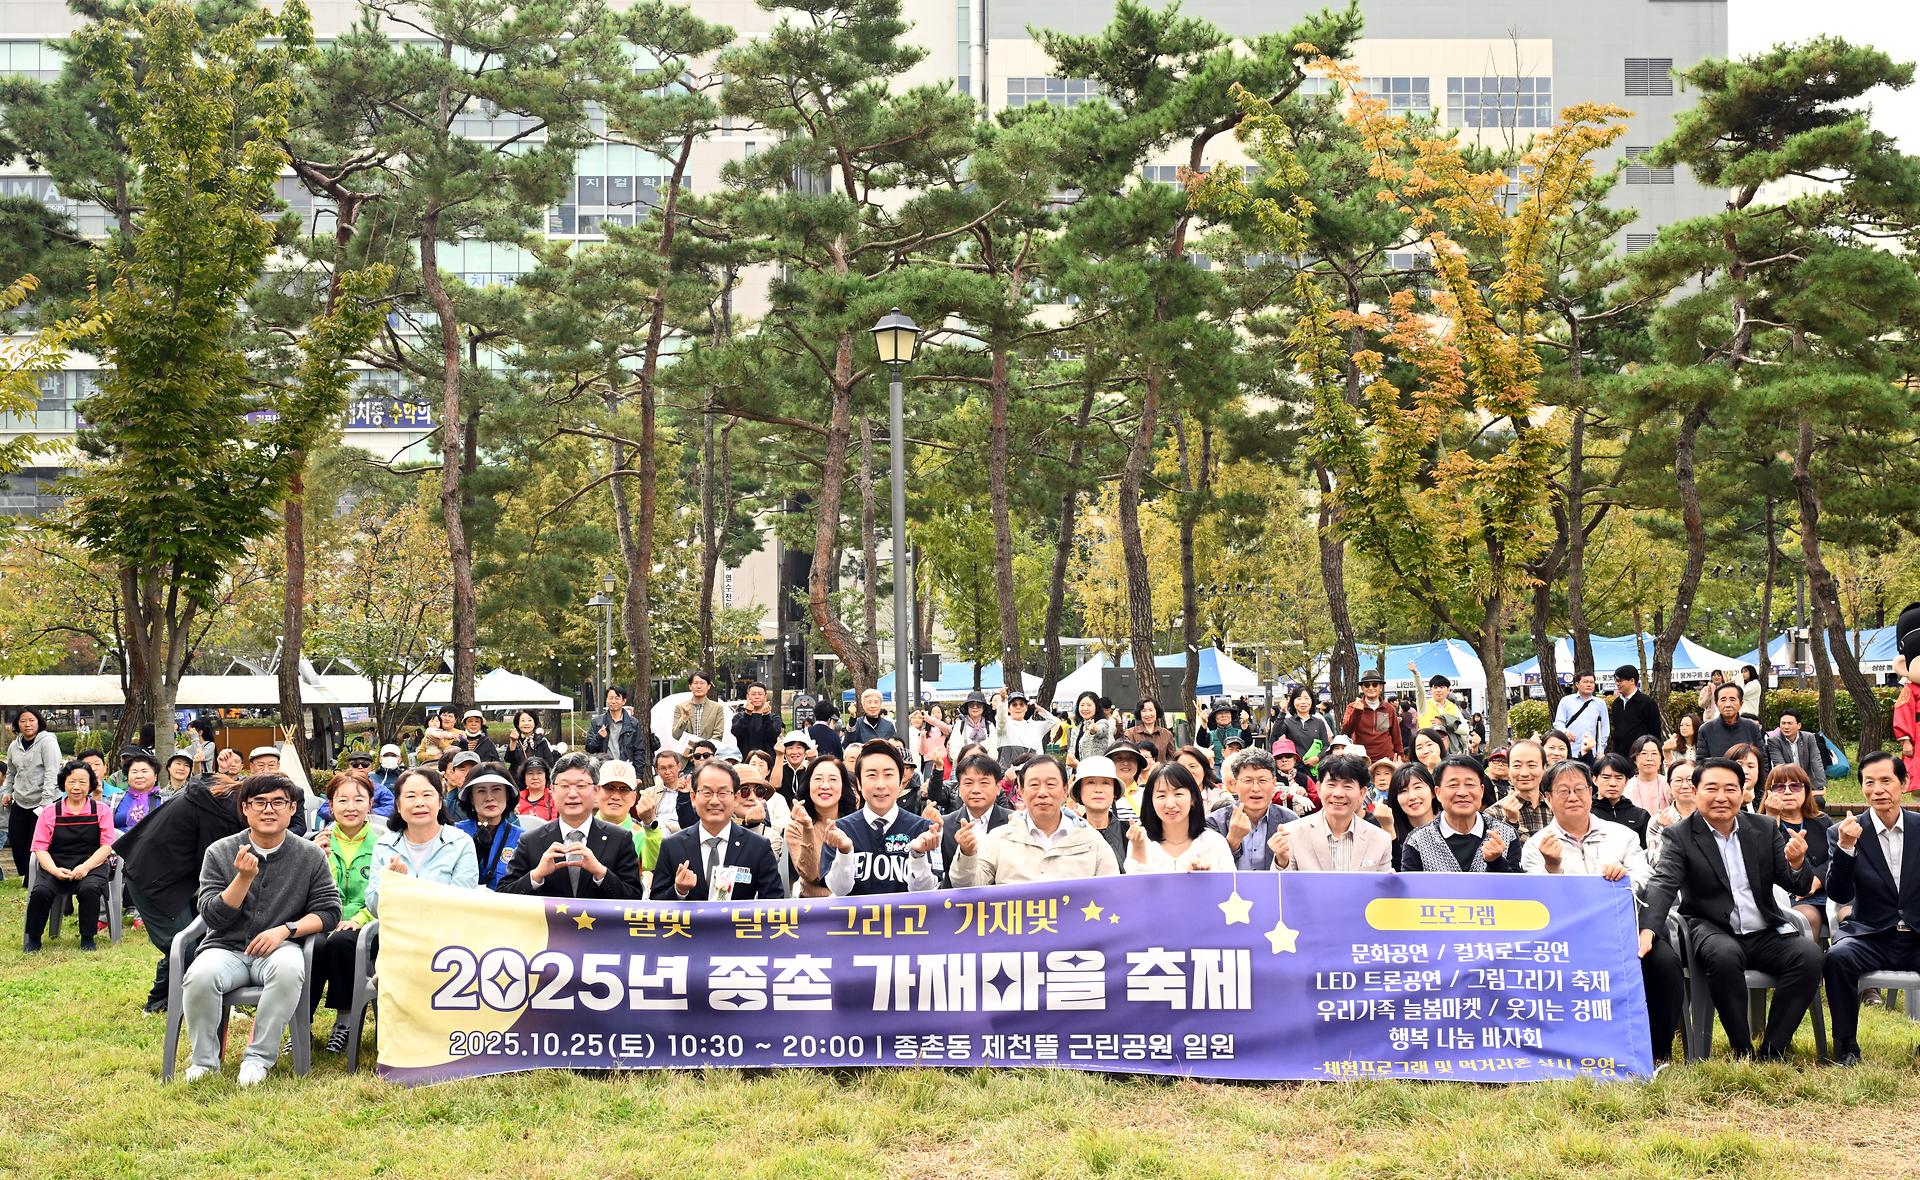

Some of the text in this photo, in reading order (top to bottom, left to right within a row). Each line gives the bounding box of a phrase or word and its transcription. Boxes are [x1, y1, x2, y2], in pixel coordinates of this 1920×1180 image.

[0, 181, 61, 201] MA
[853, 852, 909, 883] EJON
[720, 904, 811, 940] ‘달빛’
[826, 904, 930, 938] 그리고
[943, 895, 1072, 937] ‘가재빛’
[1419, 904, 1497, 927] 프로그램
[1351, 943, 1429, 964] 문화공연
[1453, 941, 1570, 963] 컬처로드공연
[433, 947, 1252, 1013] 2025년 종촌 가재마을 축제
[1316, 971, 1357, 991] LED
[1363, 970, 1442, 993] 트론공연
[1467, 968, 1563, 993] 그림그리기
[1571, 970, 1611, 993] 축제
[1316, 999, 1396, 1022] 우리가족
[1402, 998, 1482, 1021] 늘봄마켓
[1506, 998, 1564, 1022] 웃기는
[1571, 998, 1613, 1023] 경매
[450, 1031, 655, 1059] 2025.10.25(토)
[667, 1034, 744, 1058] 10:30
[782, 1034, 863, 1058] 20:00
[892, 1034, 972, 1060] 종촌동
[981, 1033, 1060, 1060] 제천뜰
[1068, 1033, 1173, 1060] 근린공원
[1182, 1034, 1235, 1060] 일원
[1388, 1027, 1543, 1051] 행복 나눔 바자회
